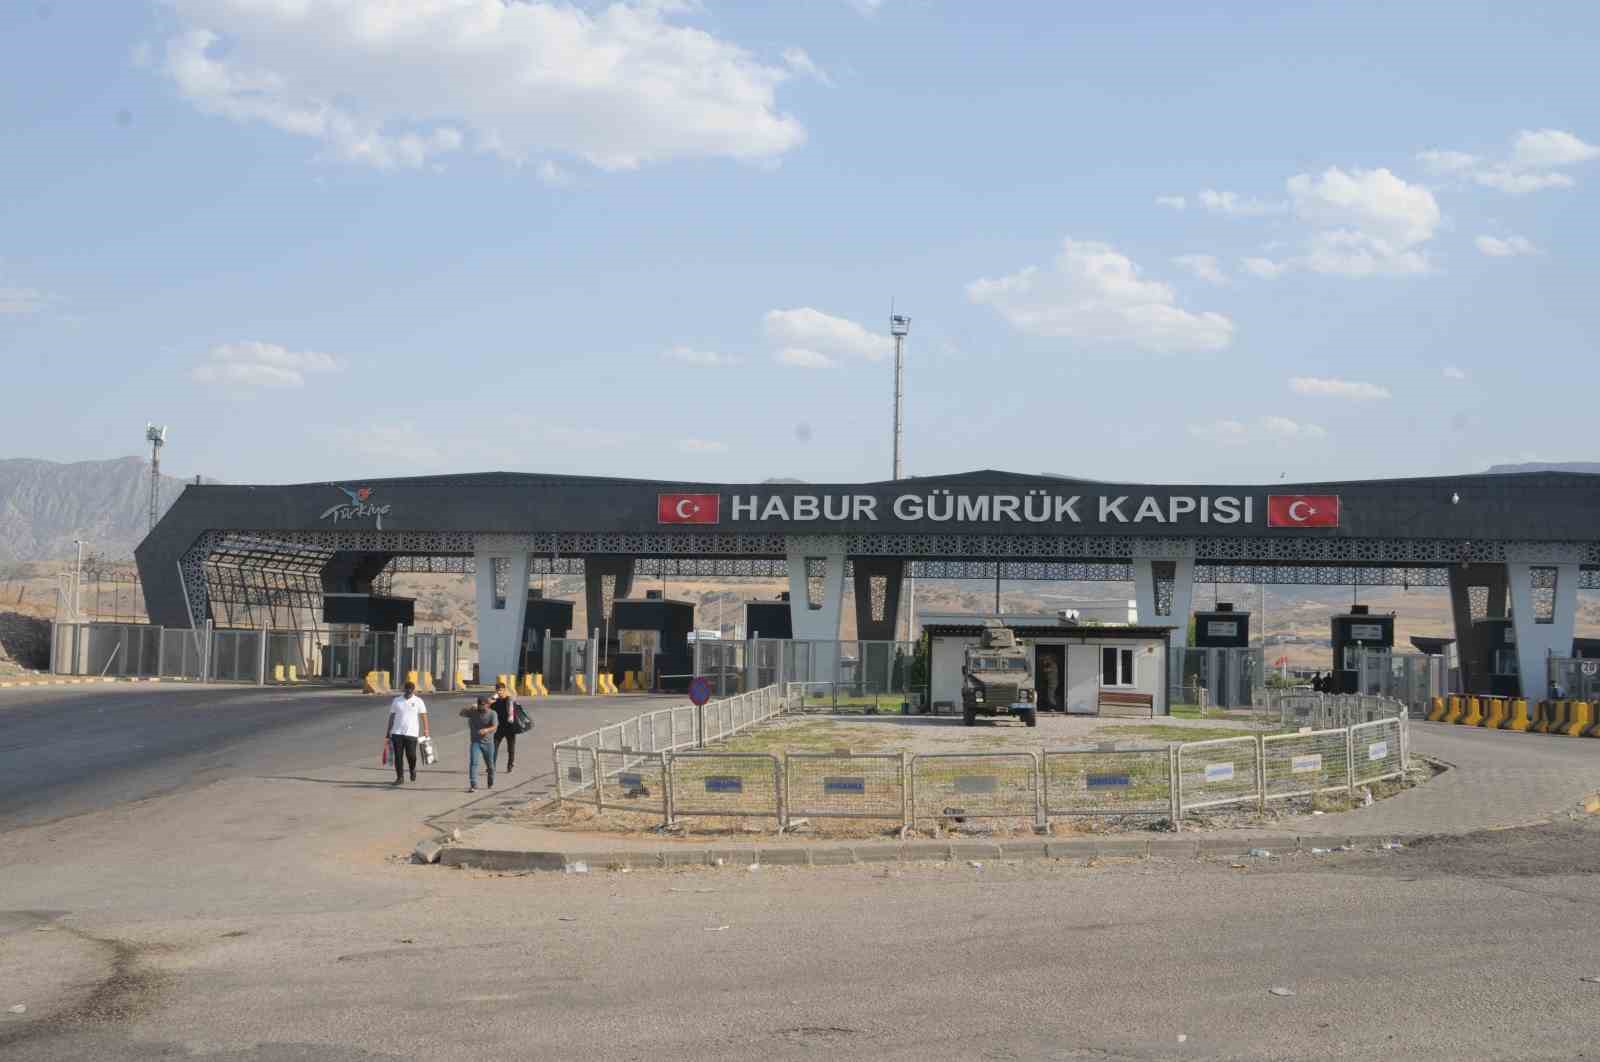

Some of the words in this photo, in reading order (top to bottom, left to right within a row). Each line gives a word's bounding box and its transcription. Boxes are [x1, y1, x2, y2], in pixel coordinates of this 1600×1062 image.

[731, 495, 878, 521] HABUR
[893, 489, 1081, 523] GÜMRÜK
[1098, 495, 1253, 523] KAPISI
